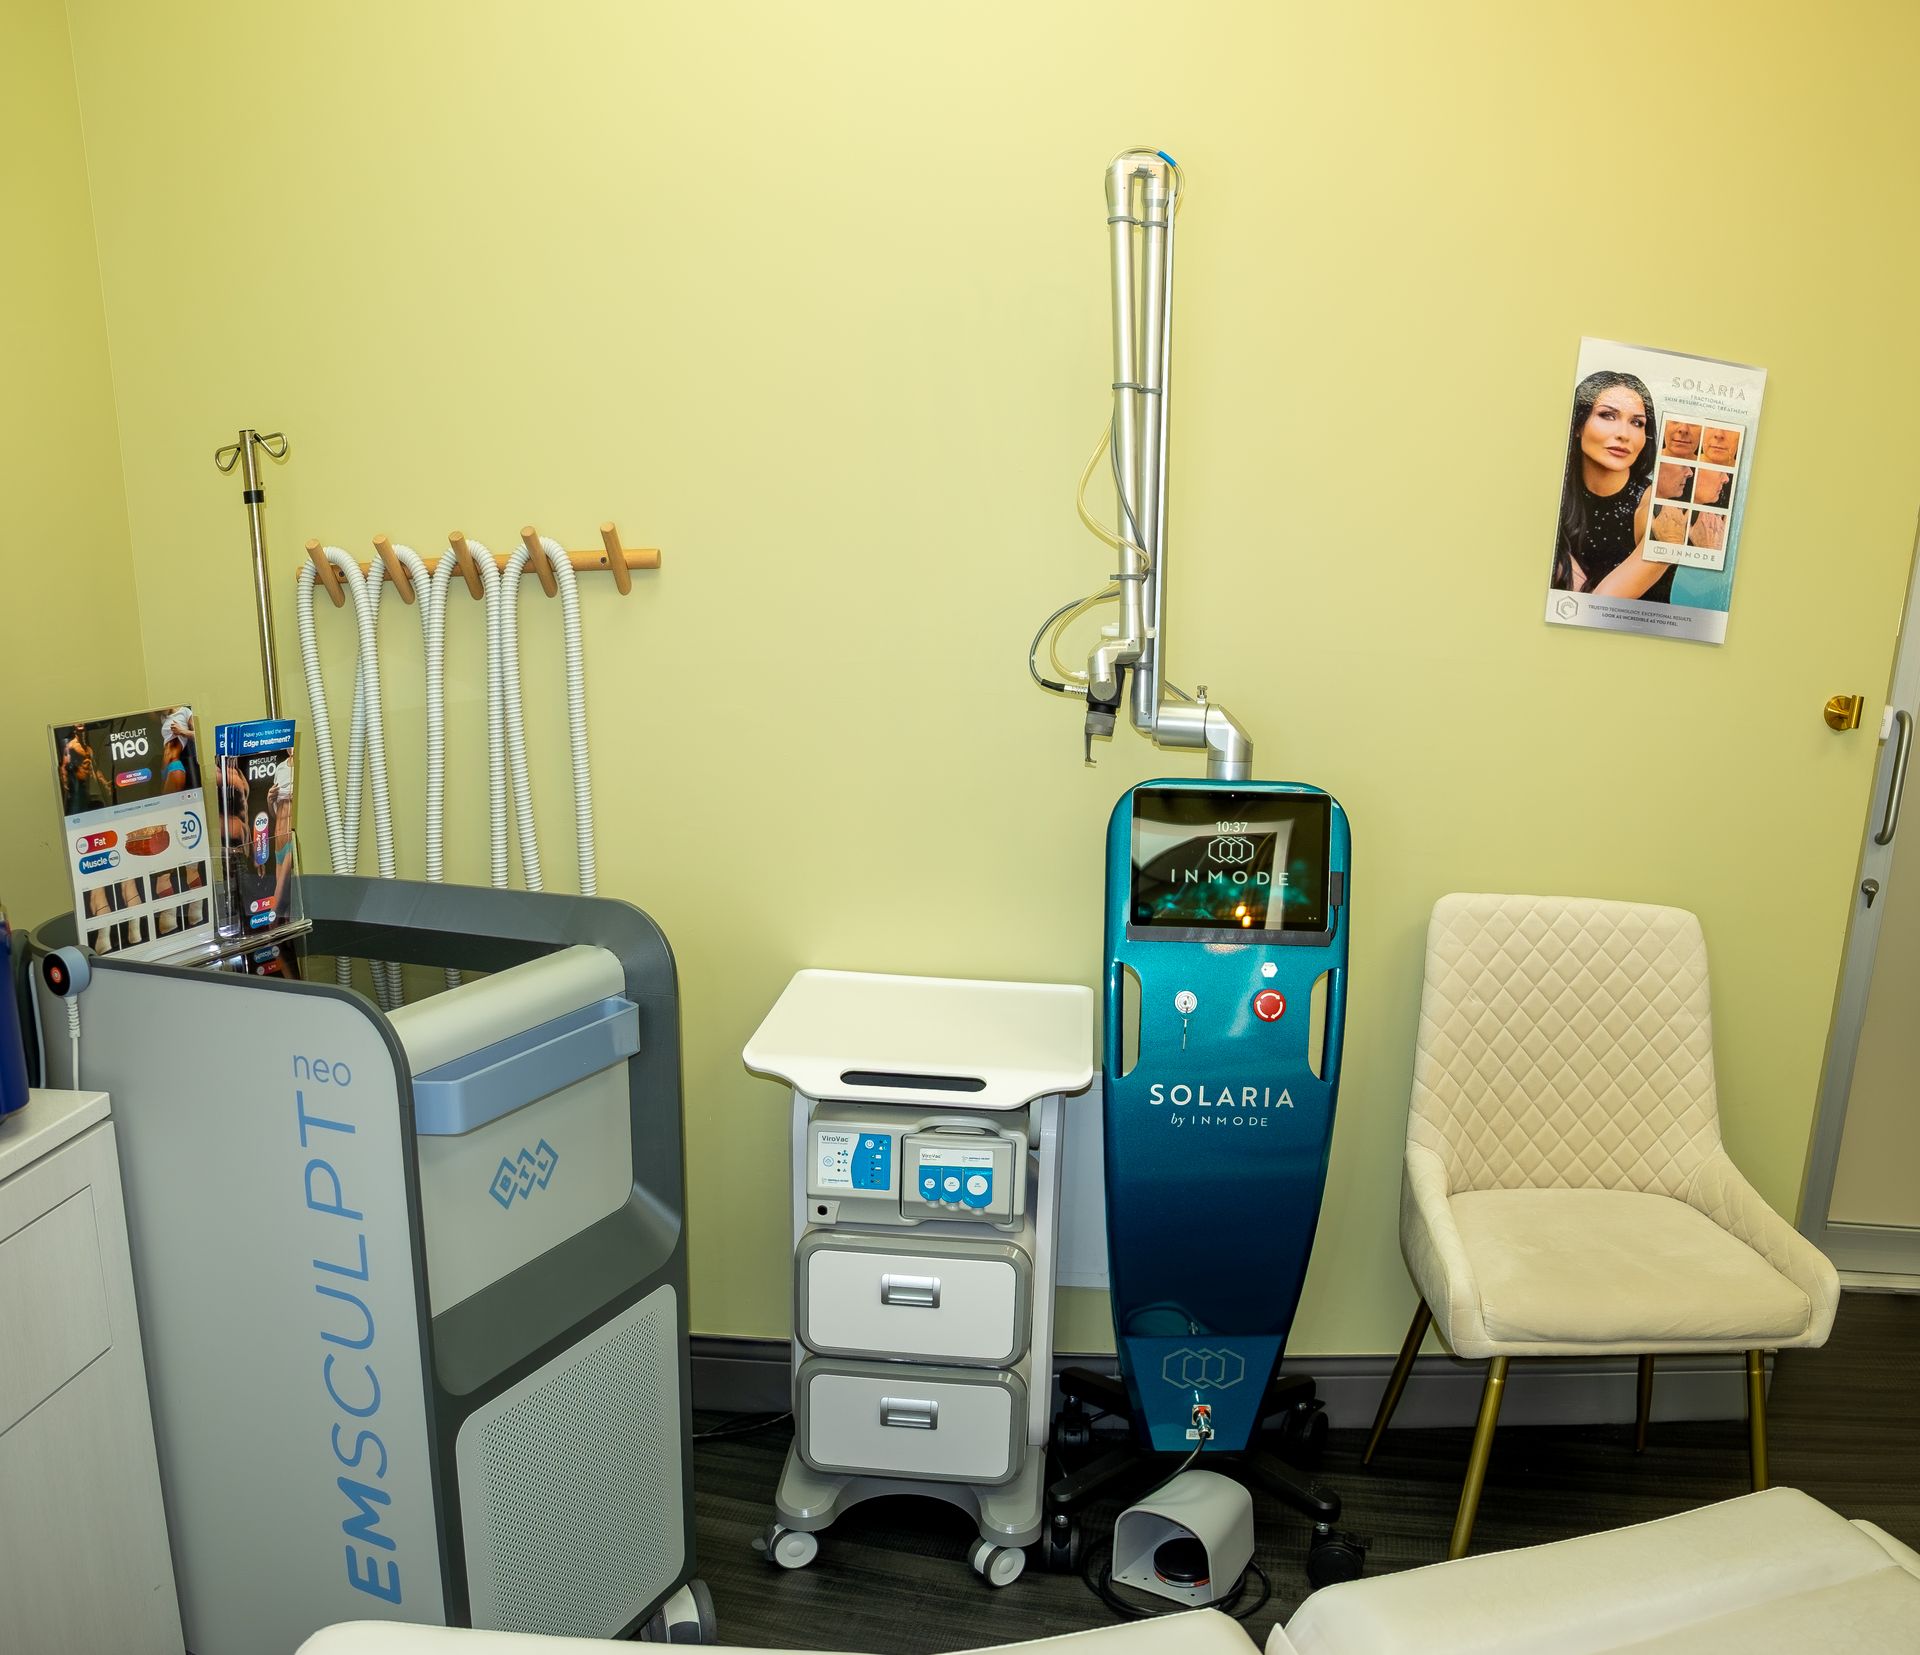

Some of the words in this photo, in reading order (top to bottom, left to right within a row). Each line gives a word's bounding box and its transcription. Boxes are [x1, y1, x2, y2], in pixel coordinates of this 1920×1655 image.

[1671, 376, 1746, 401] SOLARIA
[1690, 394, 1725, 406] FRACTIONAL
[1717, 405, 1748, 416] TREATMENT
[1671, 548, 1716, 562] INMODE
[110, 728, 147, 742] EMSCULPT
[243, 739, 259, 748] Edge
[260, 735, 291, 746] treatment?
[111, 737, 149, 761] neo
[249, 755, 277, 766] EMSCULPT
[249, 762, 277, 781] neo
[180, 819, 196, 835] 30
[1215, 821, 1248, 833] 10:37
[93, 837, 106, 847] Fat
[82, 857, 108, 870] Muscle
[1171, 868, 1289, 886] INMODE
[262, 900, 271, 908] Fat
[251, 915, 269, 926] Muscle
[292, 1054, 352, 1087] neo
[1149, 1083, 1295, 1108] SOLARIA
[1170, 1112, 1186, 1128] by
[1191, 1115, 1269, 1127] INMODE
[821, 1135, 849, 1143] ViroVac
[296, 1089, 402, 1605] EMSCULPT
